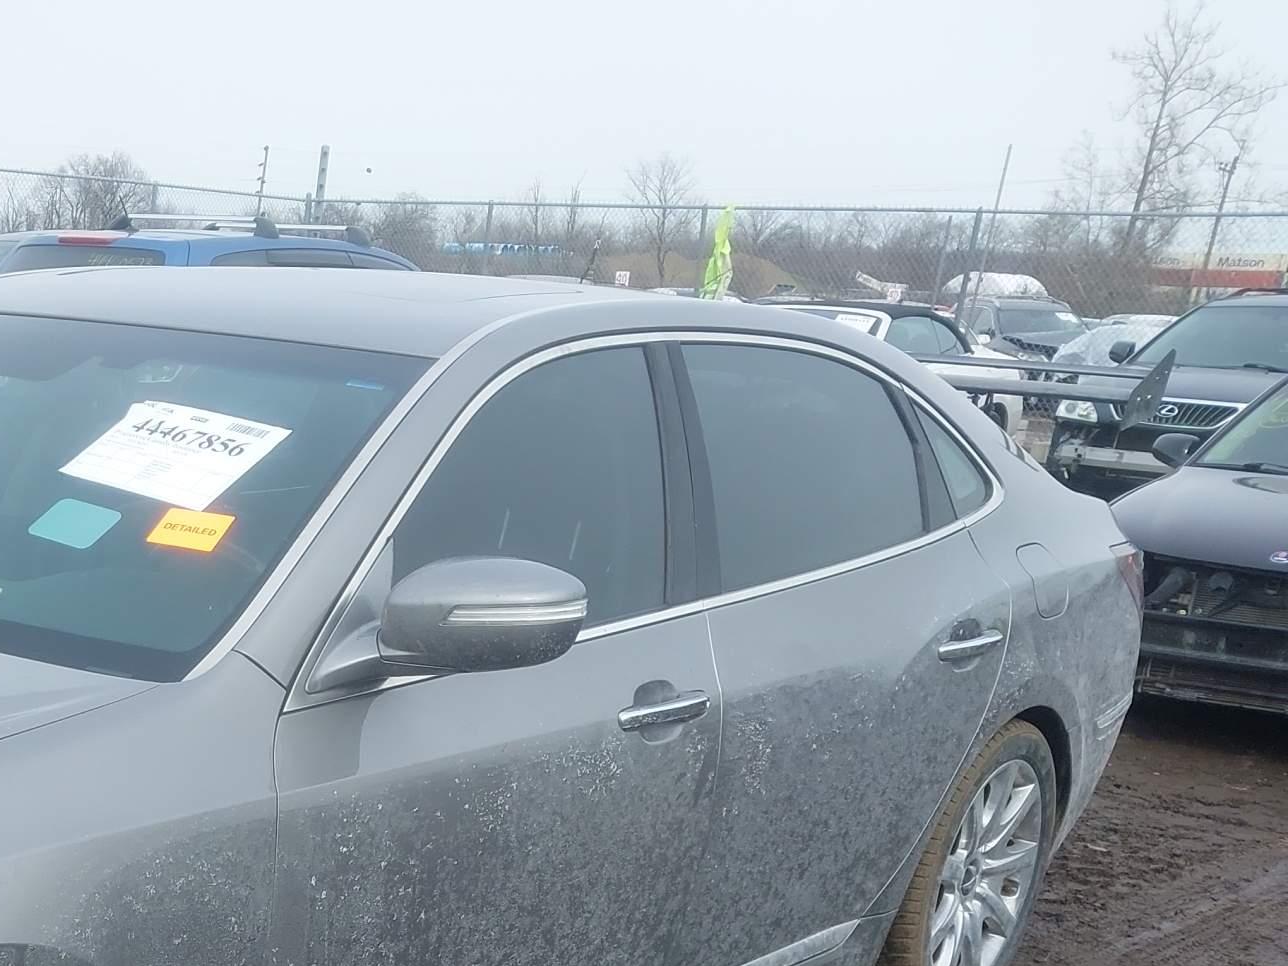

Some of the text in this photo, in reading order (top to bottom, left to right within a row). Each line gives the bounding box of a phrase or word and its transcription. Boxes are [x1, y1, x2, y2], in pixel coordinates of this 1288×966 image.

[1217, 257, 1265, 268] Matson
[132, 418, 252, 457] 44467856
[163, 522, 217, 536] DETAILED
